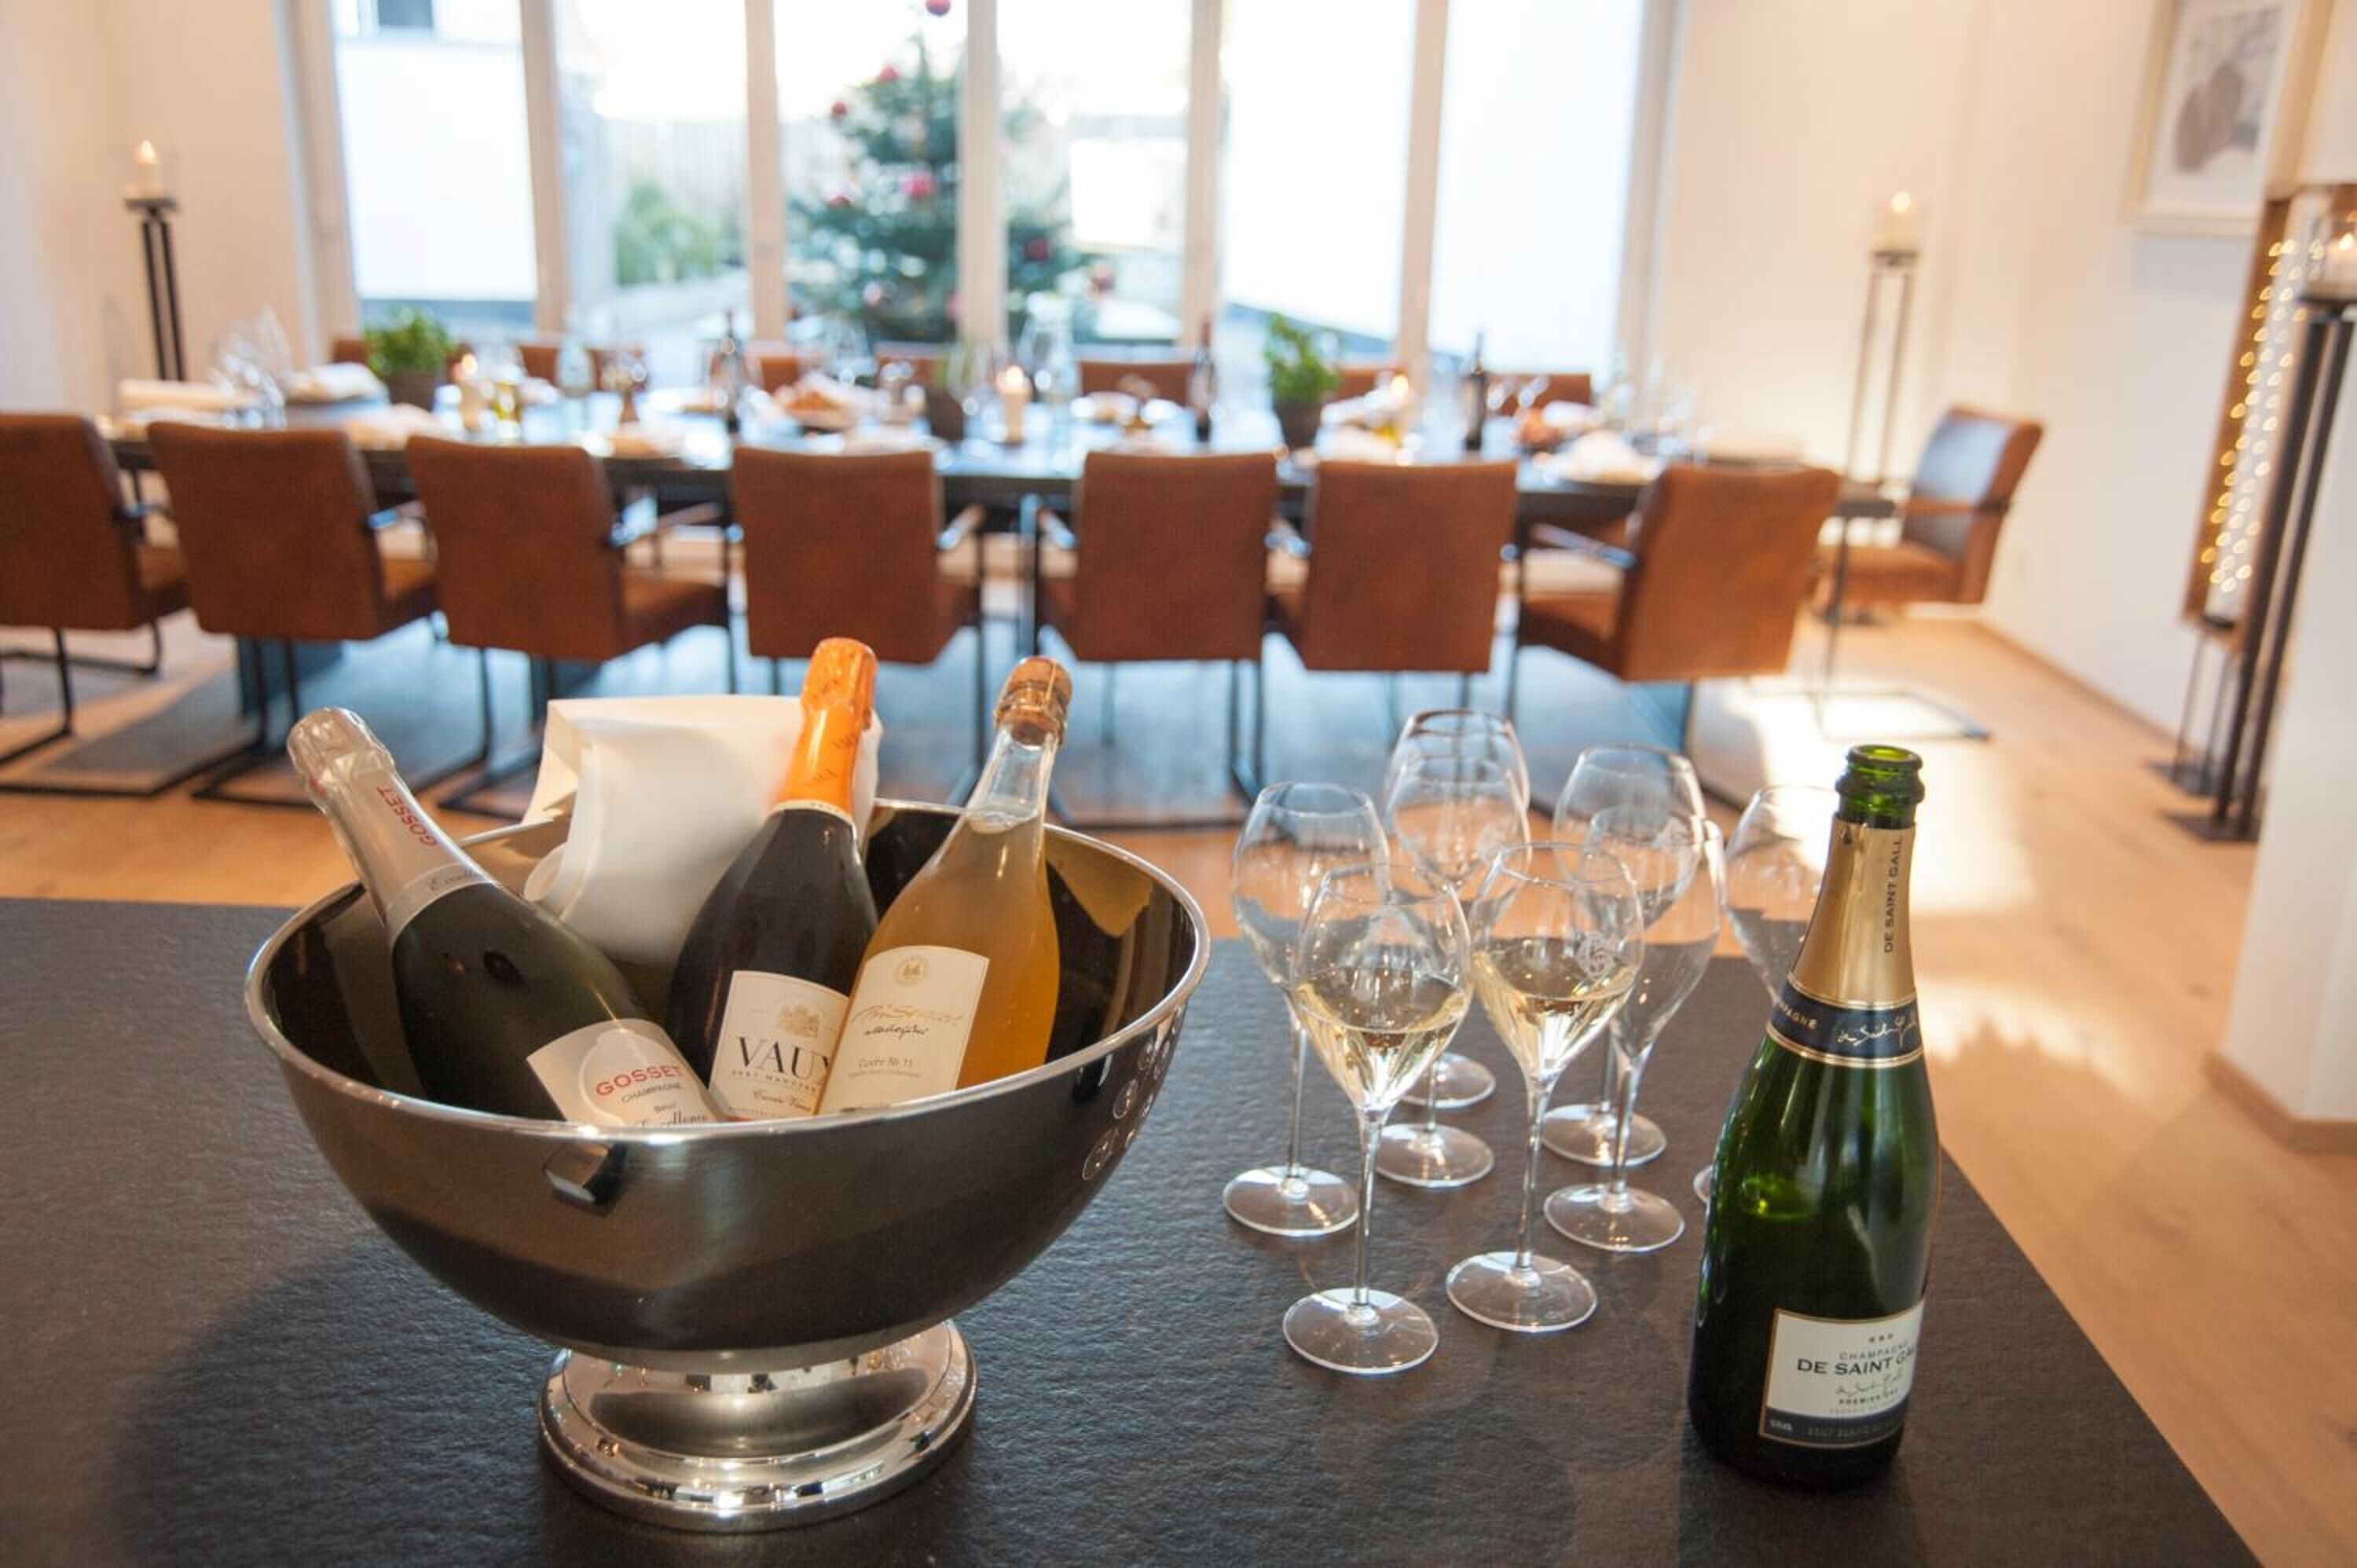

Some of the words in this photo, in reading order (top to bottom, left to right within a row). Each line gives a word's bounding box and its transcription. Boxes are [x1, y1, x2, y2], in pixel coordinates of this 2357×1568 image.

[376, 785, 438, 846] GOSSET
[1889, 835, 1903, 877] GALL
[1886, 881, 1897, 928] SAINT
[1884, 932, 1894, 953] DE
[596, 1065, 681, 1096] GOSSET
[621, 1082, 682, 1103] CHAMPAGNE
[1798, 1357, 1828, 1375] DE
[1835, 1356, 1893, 1376] SAINT
